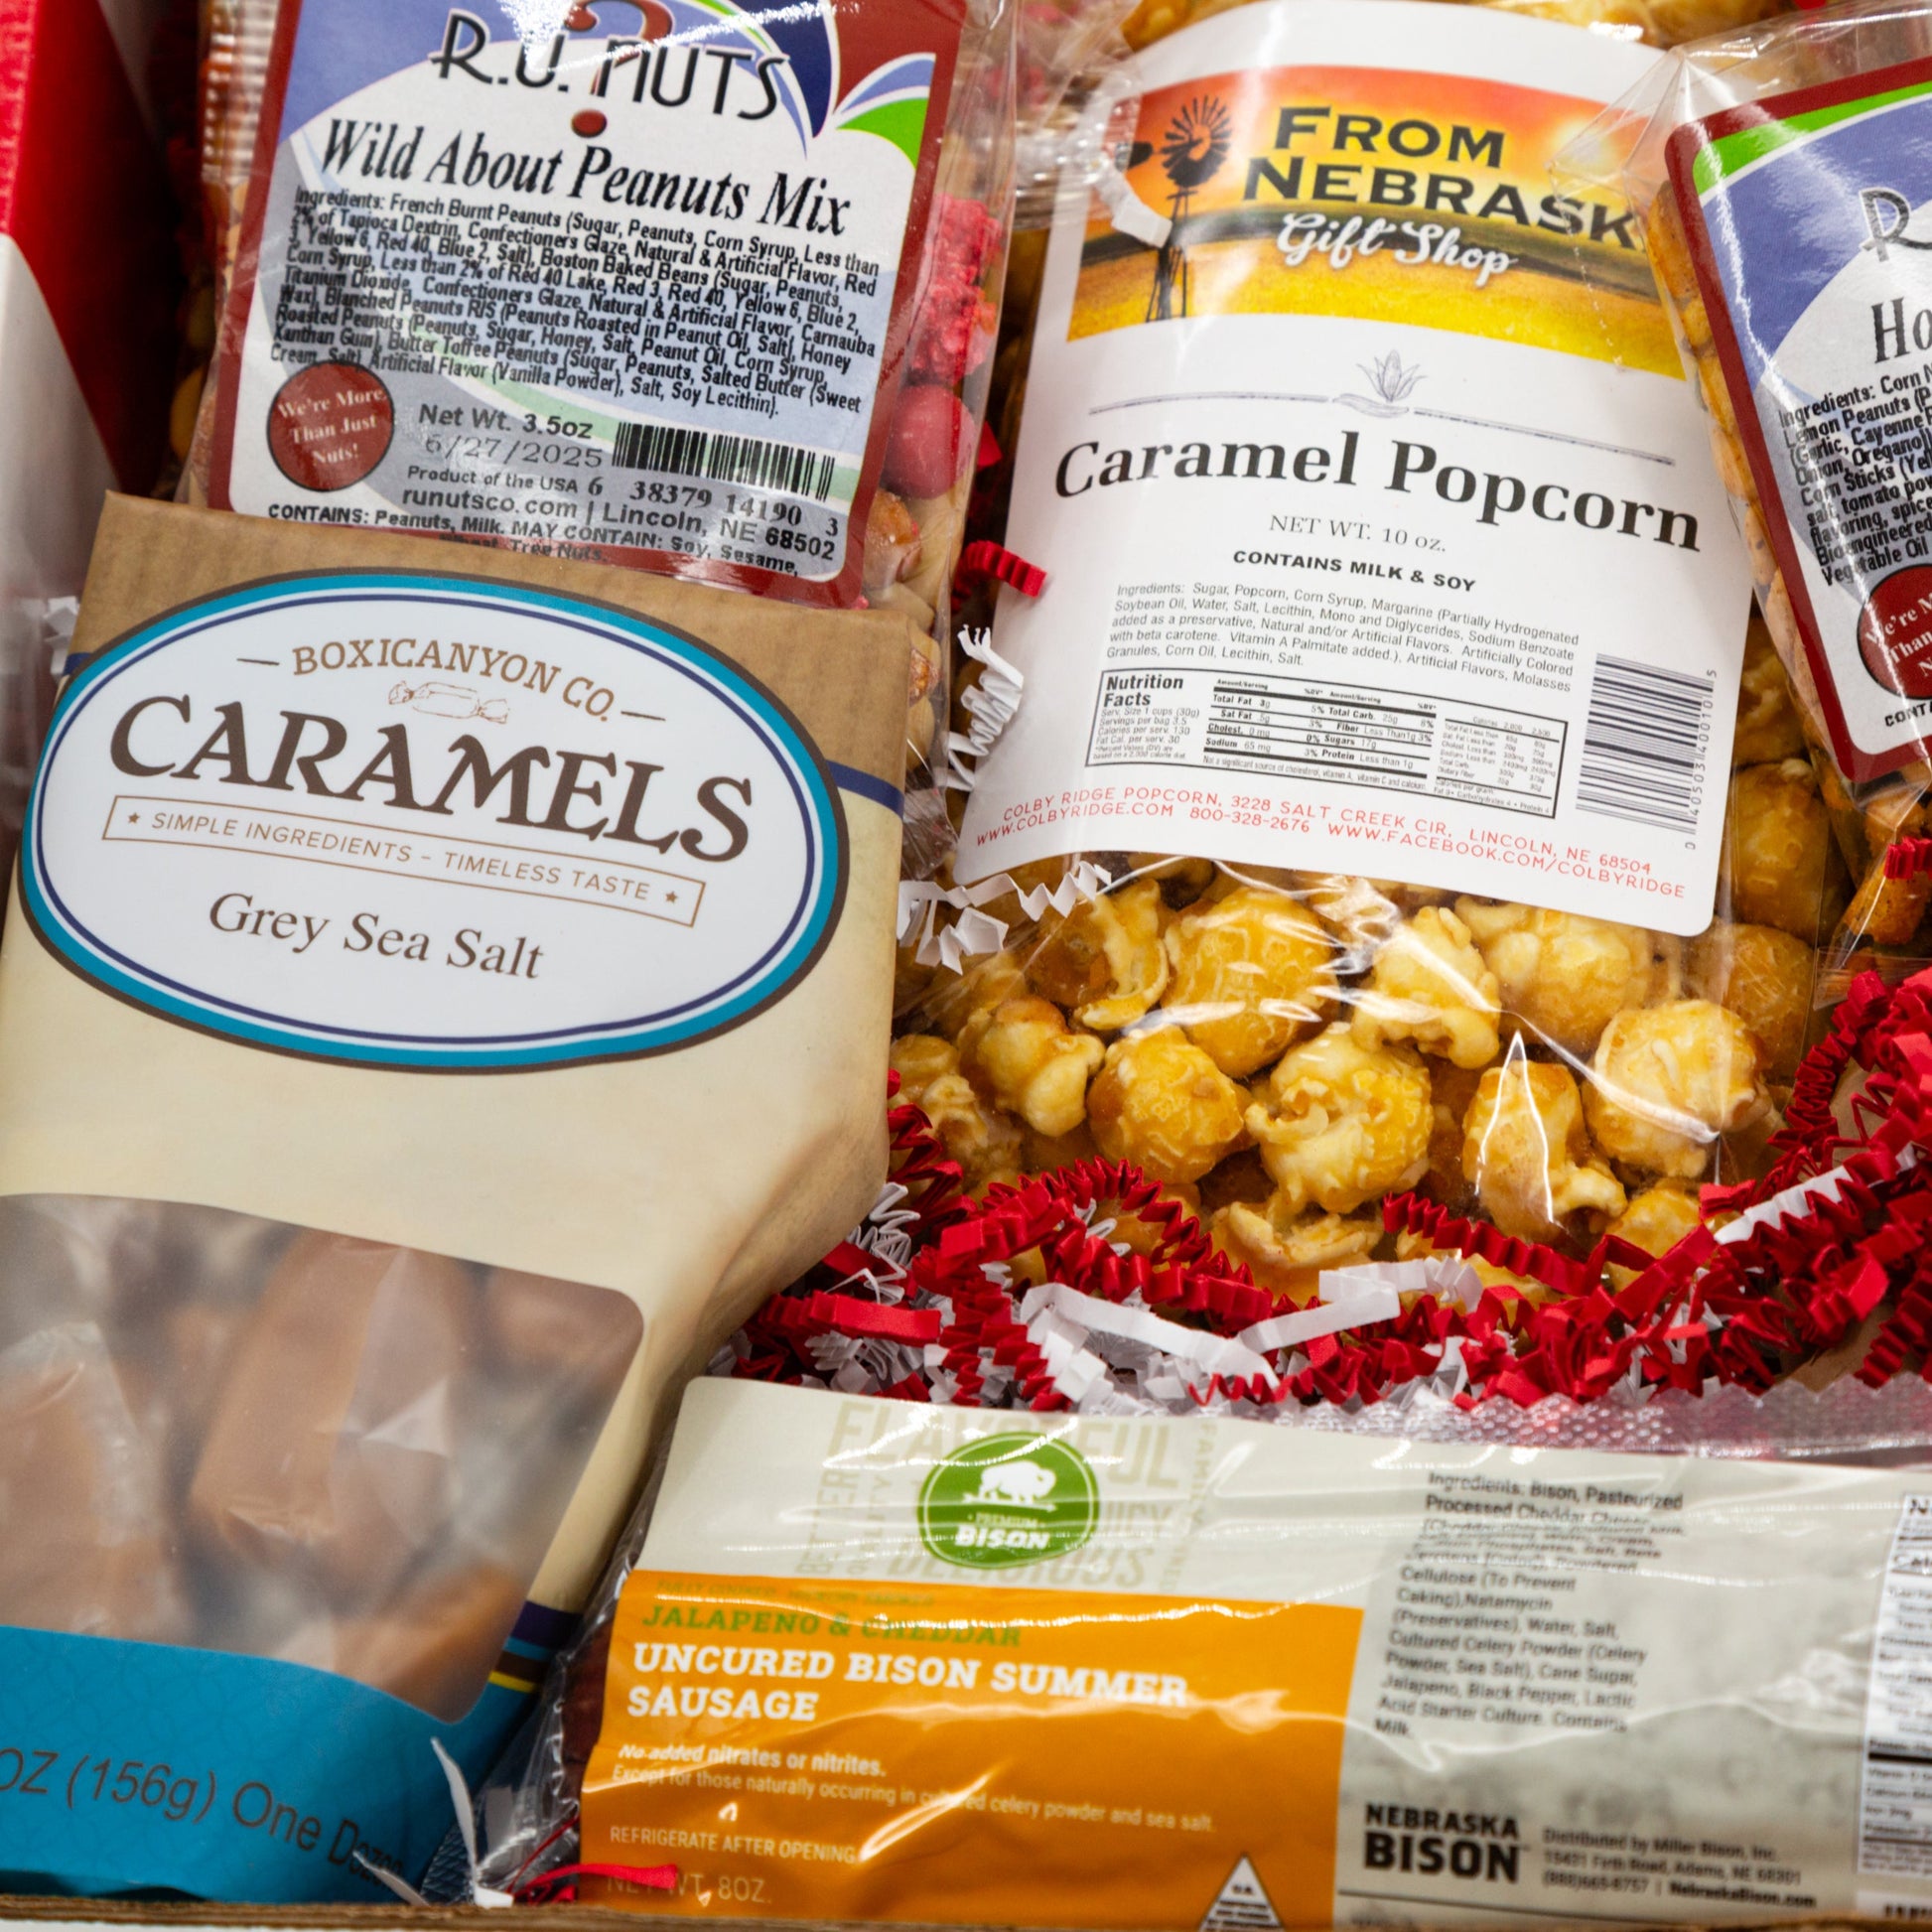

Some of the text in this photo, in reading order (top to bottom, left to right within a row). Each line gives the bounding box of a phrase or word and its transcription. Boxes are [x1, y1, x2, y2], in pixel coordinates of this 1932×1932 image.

[1273, 104, 1508, 170] FROM
[322, 117, 852, 236] Wild About Peanuts Mix
[1242, 156, 1644, 252] NEBRASK
[296, 187, 880, 277] Ingredients: French Burnt Peanuts (Sugar, Peanuts, Corn Syrup, Less than
[1276, 211, 1519, 288] Gift Shop
[276, 396, 331, 421] We're
[369, 349, 780, 419] Artificial Flavor (Vanilla Powder), Salt, Soy Lecithin).
[1778, 371, 1922, 429] Ingredients: Corn
[290, 413, 378, 446] Than Just
[419, 403, 595, 440] Net Wt. 3.5oz
[311, 442, 359, 468] Nuts!
[407, 465, 579, 493] Product of the USA
[1053, 430, 1360, 499] Caramel
[402, 486, 836, 562] runutsco.com Lincoln, NE 68502
[587, 476, 840, 538] 6 38379 14190 3
[1384, 439, 1702, 553] Popcorn
[268, 502, 799, 577] CONTAINS: Peanuts, Milk. MAY CONTAIN: Soy, Sesame,
[1269, 514, 1447, 553] NET WT. 10 oz.
[1233, 550, 1476, 593] CONTAINS MILK & SOY
[1114, 598, 1166, 614] Soybean
[1192, 598, 1229, 614] Water,
[1233, 601, 1260, 616] Salt,
[1264, 603, 1316, 620] Lecithin,
[1319, 608, 1356, 624] Mono
[1359, 612, 1383, 626] and
[1385, 616, 1465, 642] Diglycerides,
[1468, 628, 1516, 648] Sodium
[1519, 639, 1576, 661] Benzoate
[1117, 583, 1185, 599] Ingredients:
[1192, 582, 1229, 598] Sugar,
[1234, 584, 1290, 603] Popcorn,
[1294, 589, 1324, 605] Corn
[1371, 598, 1434, 621] Margarine
[1437, 608, 1491, 630] (Partially
[1493, 618, 1581, 646] Hydrogenated
[292, 637, 562, 695] BOXICANYON
[1106, 674, 1184, 693] Nutrition
[1102, 691, 1152, 708] Facts
[108, 693, 754, 864] CARAMELS
[150, 810, 650, 902] SIMPLE INGREDIENTS TIMELESS TASTE
[976, 801, 1687, 899] WWW.COLBYRIDGE.COM 800-328-2676 WWW.FACEBOOK.COM/COLBYRIDGE
[1003, 794, 1055, 822] COLBY
[1061, 787, 1116, 805] RIDGE
[1123, 786, 1224, 808] POPCORN,
[1230, 795, 1273, 812] 3228
[1279, 800, 1332, 820] SALT
[1340, 807, 1406, 830] CREEK
[1468, 827, 1558, 860] LINCOLN,
[1566, 846, 1590, 863] NE
[1597, 852, 1653, 875] 68504
[208, 893, 545, 981] Grey Sea Salt
[1425, 1494, 1513, 1518] Processed
[1587, 1485, 1685, 1511] Pasteurized
[954, 1525, 1051, 1550] BISON
[1400, 1565, 1477, 1587] Cellulose
[1512, 1573, 1577, 1592] Prevent
[828, 1613, 851, 1637] &
[625, 1685, 820, 1724] SAUSAGE
[631, 1642, 1189, 1709] UNCURED BISON SUMMER
[648, 1743, 706, 1763] added
[708, 1745, 781, 1769] nitrates
[785, 1750, 806, 1770] or
[811, 1751, 887, 1778] nitrites.
[66, 1753, 216, 1825] (156g)
[232, 1780, 323, 1852] One
[612, 1763, 667, 1787] Except
[669, 1767, 693, 1785] for
[696, 1770, 743, 1790] those
[746, 1774, 816, 1802] naturally
[819, 1780, 897, 1808] occurring
[990, 1794, 1042, 1818] celery
[1043, 1798, 1107, 1822] powder
[1110, 1805, 1143, 1826] and
[1145, 1811, 1176, 1830] sea
[1364, 1802, 1520, 1841] NEBRASKA
[610, 1826, 719, 1853] REFRIGERATE
[722, 1834, 775, 1858] AFTER
[1363, 1830, 1523, 1885] BISON
